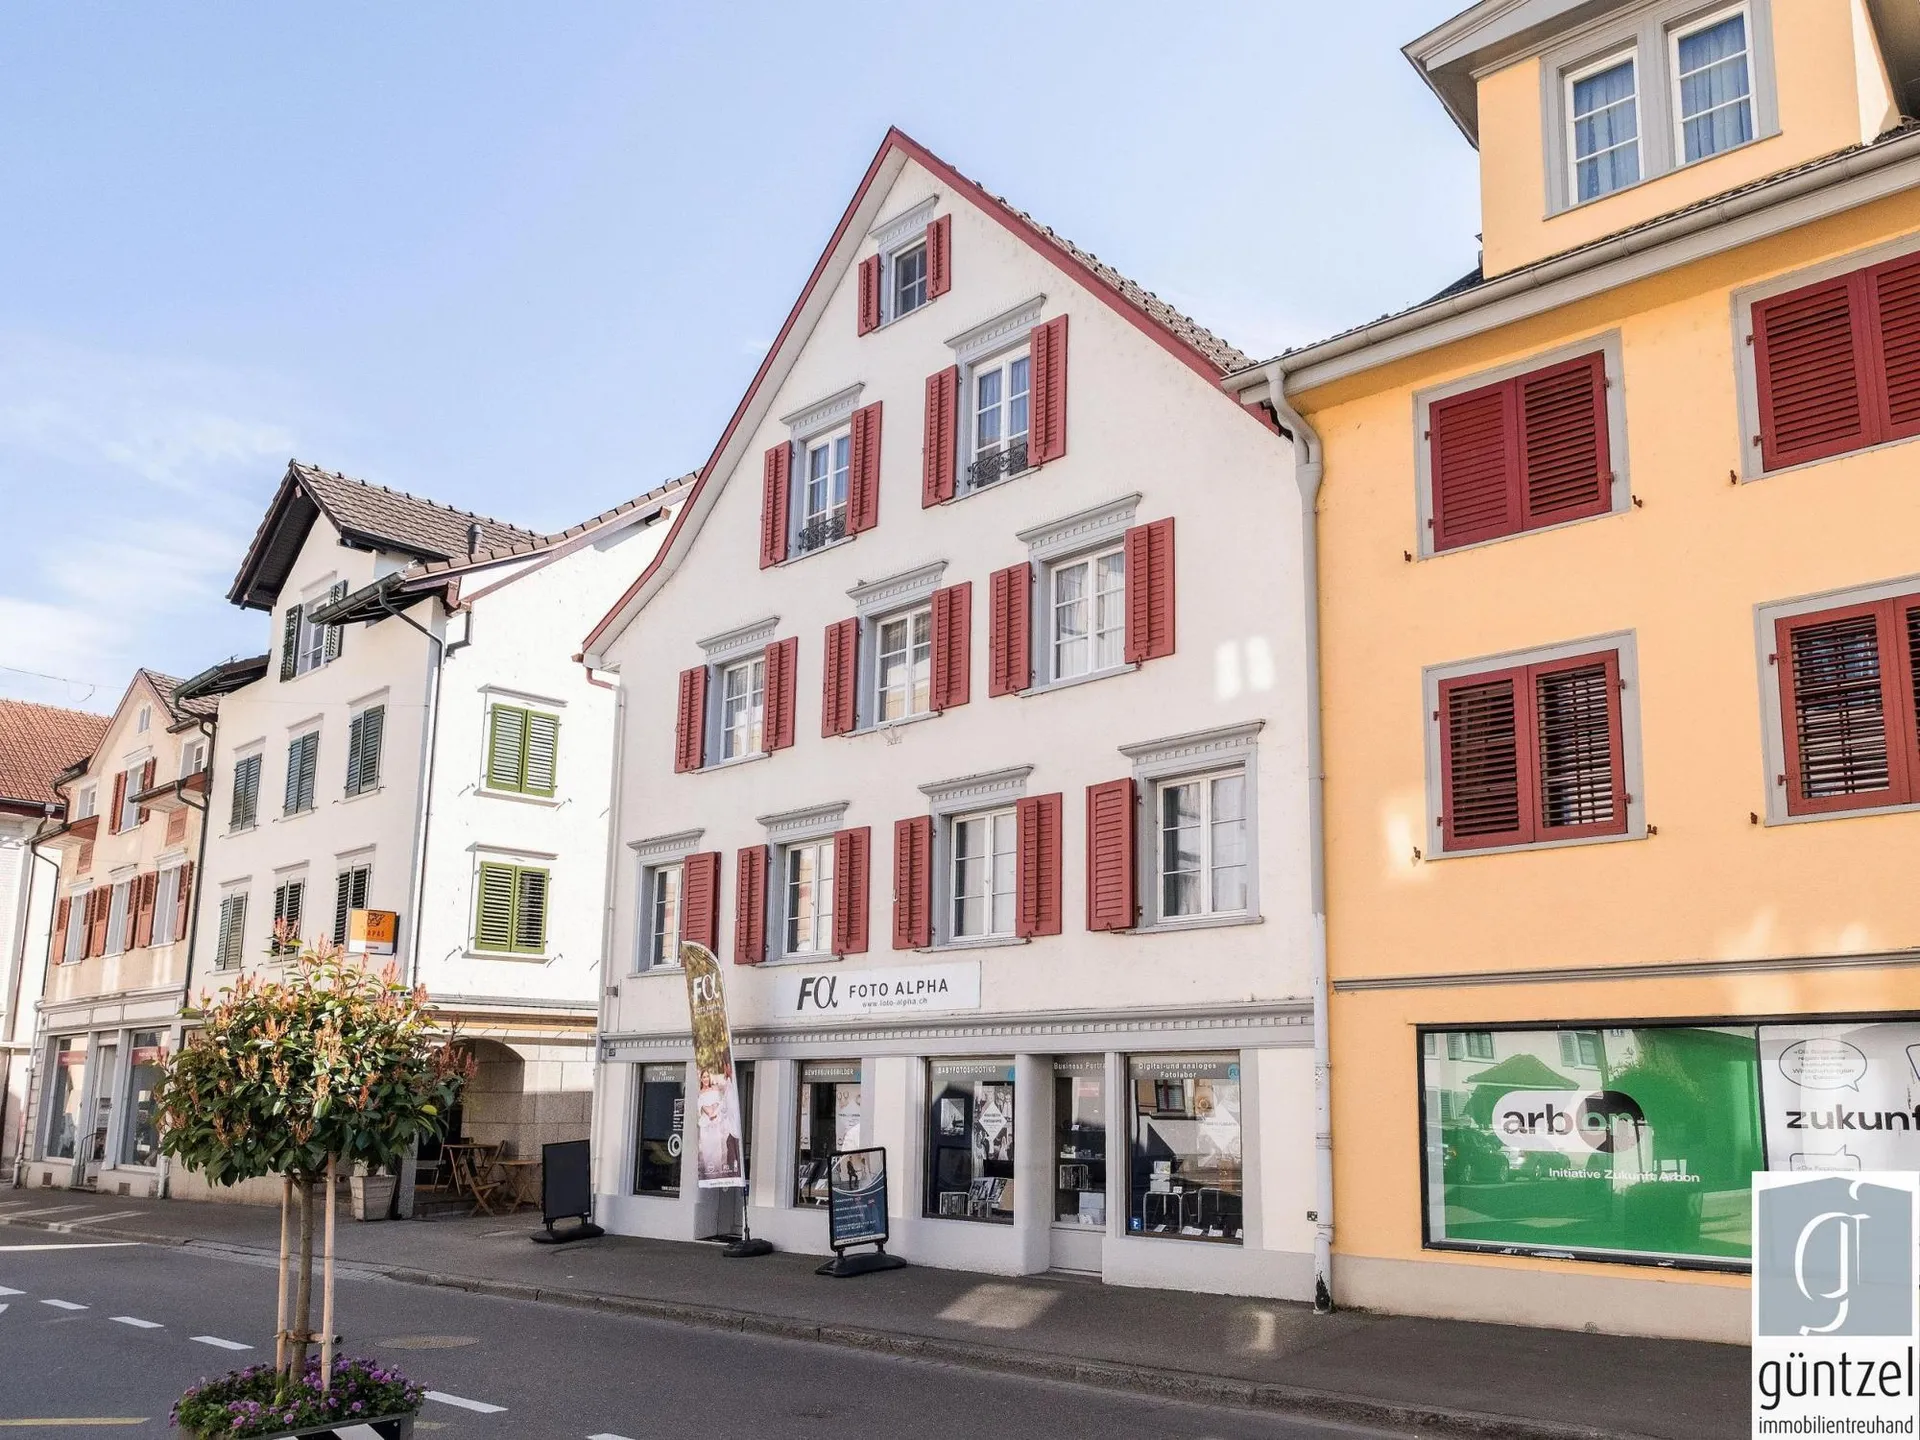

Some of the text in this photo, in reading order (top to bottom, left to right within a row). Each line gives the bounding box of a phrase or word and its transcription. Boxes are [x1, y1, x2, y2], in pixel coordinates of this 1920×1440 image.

[849, 978, 949, 998] FOTO ALPHA
[1053, 1062, 1083, 1070] Business
[1160, 1071, 1197, 1079] Fotolabor
[1502, 1104, 1635, 1136] arbon
[1549, 1167, 1601, 1179] Initiative
[1659, 1172, 1700, 1182] Arbon
